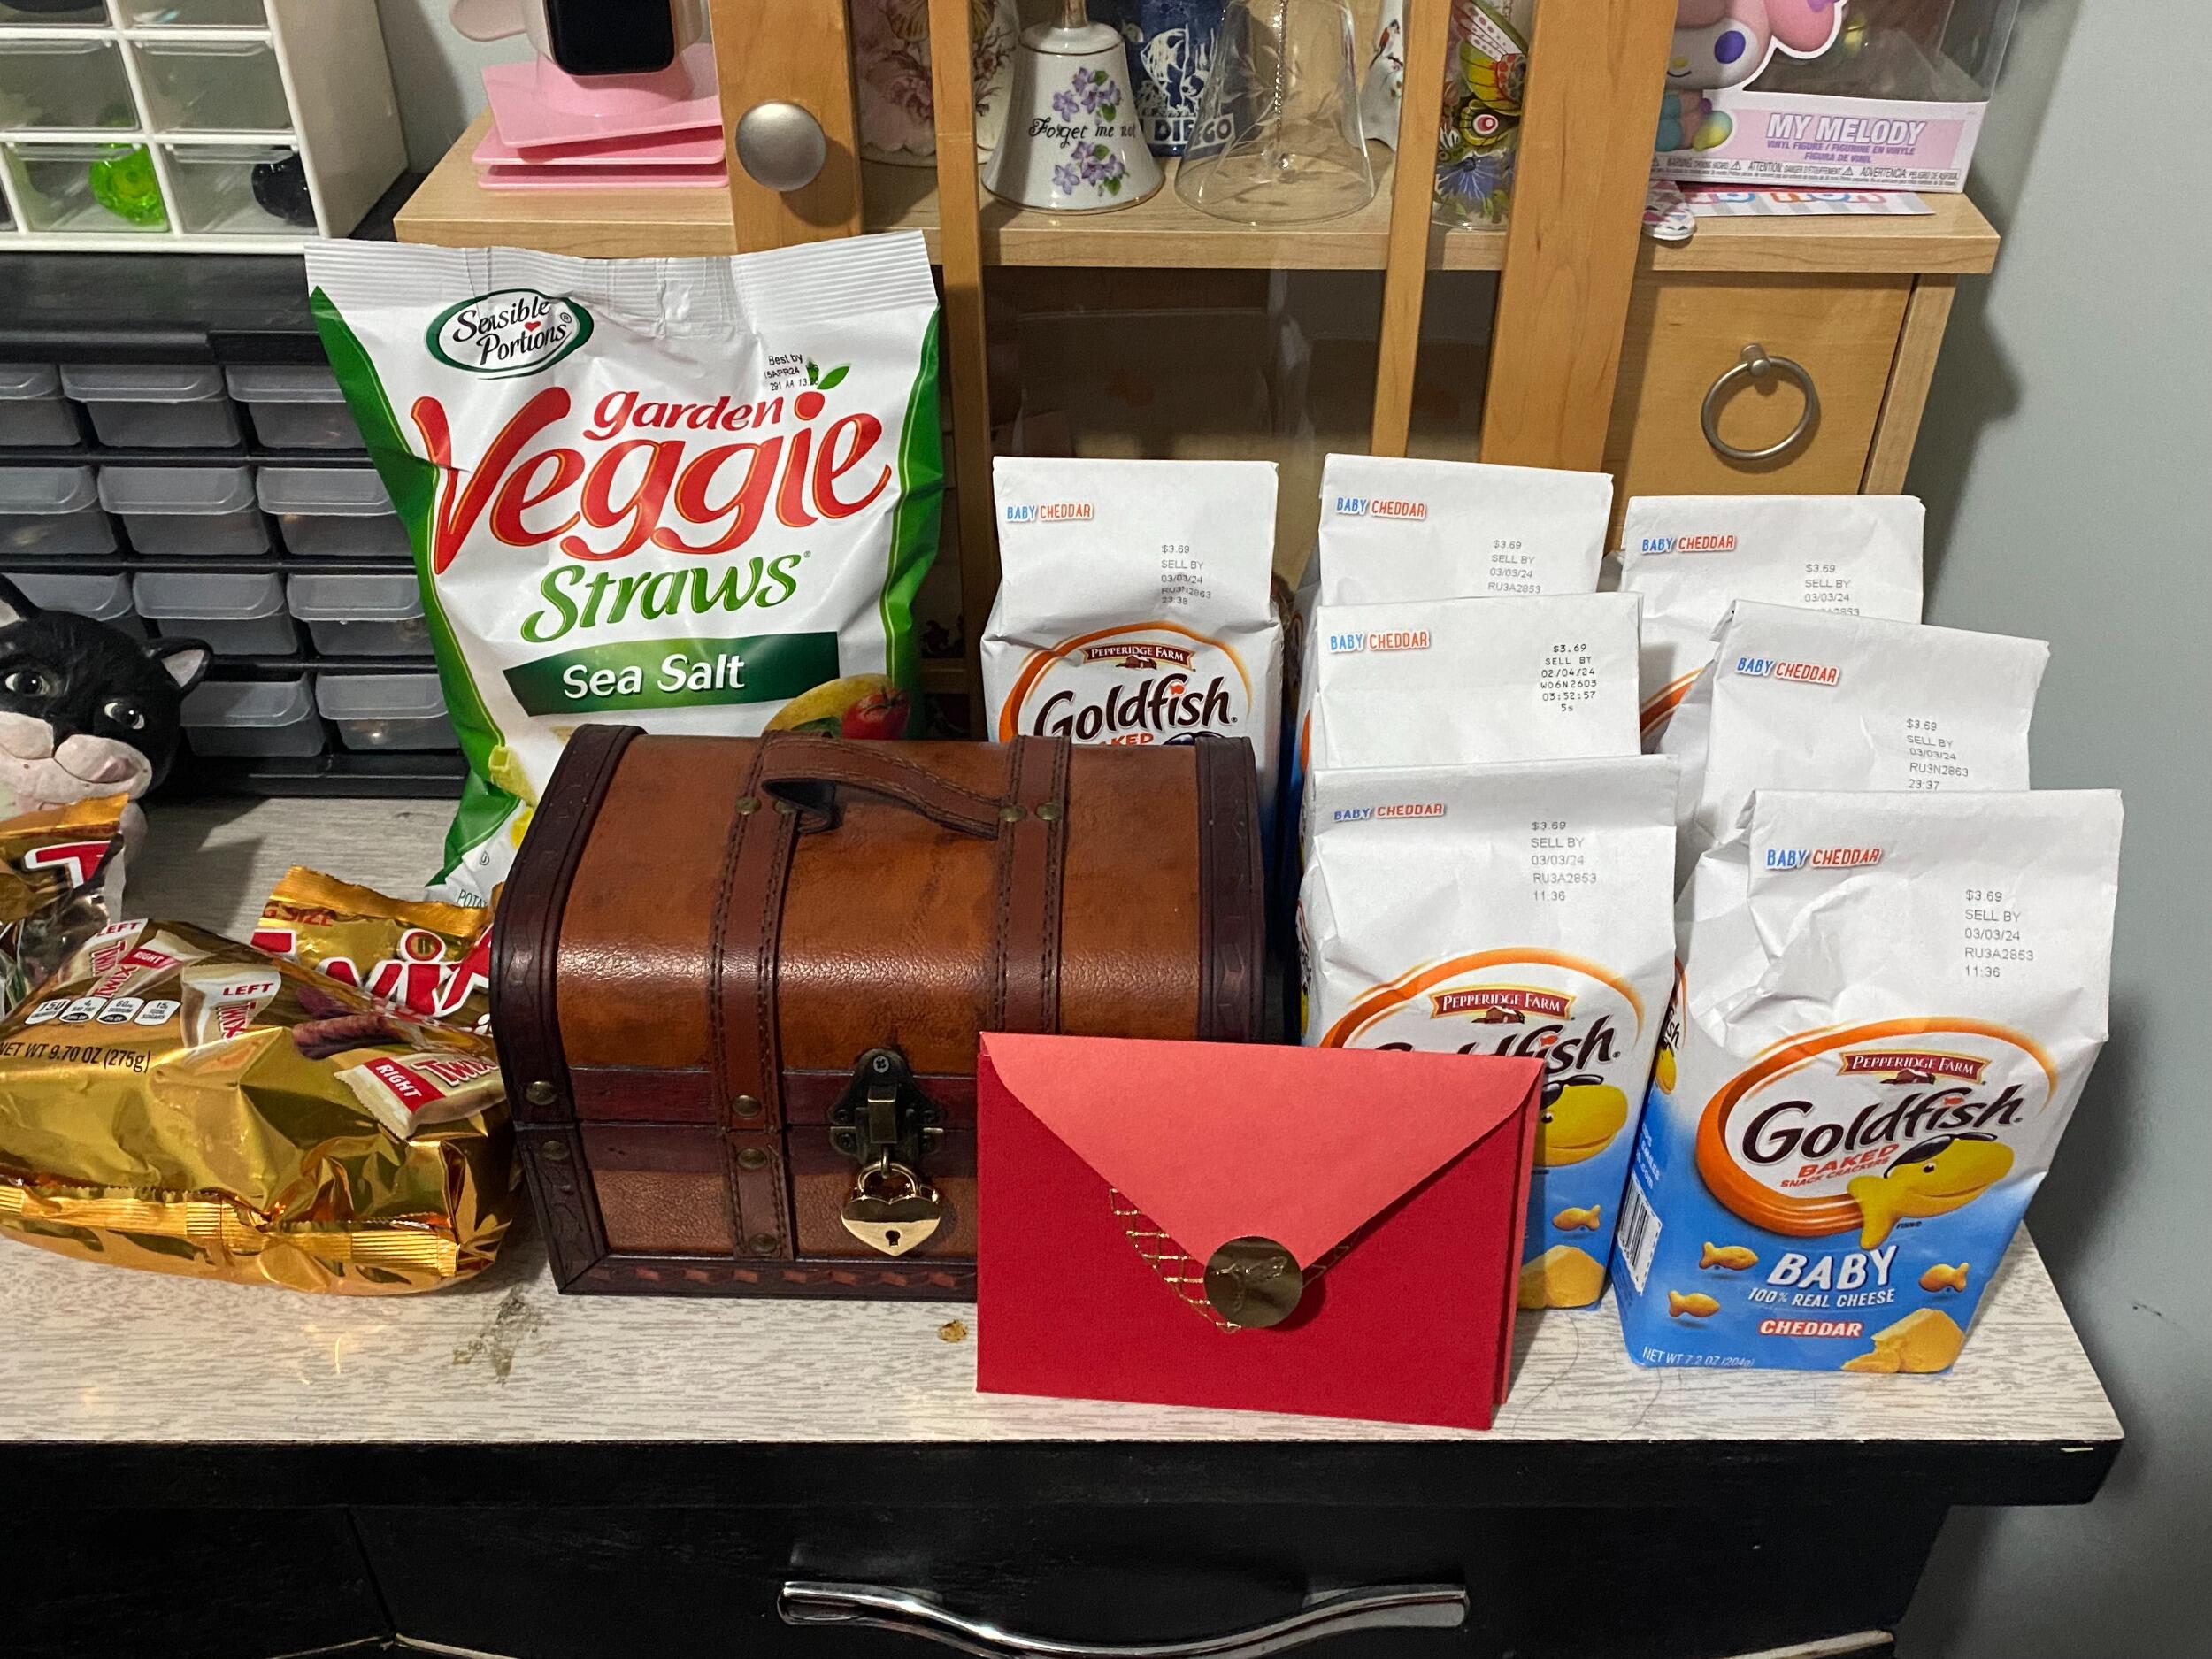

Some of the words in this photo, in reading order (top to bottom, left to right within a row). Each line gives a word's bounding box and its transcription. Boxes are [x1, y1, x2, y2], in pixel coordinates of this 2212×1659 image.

[1028, 117, 1088, 149] Forget
[1094, 124, 1114, 138] me
[1766, 112, 1813, 141] MY
[1815, 115, 1927, 146] MELODY
[1766, 141, 1790, 150] VINYL
[1793, 142, 1824, 150] FIGURE
[1831, 143, 1870, 153] FIGURINE
[1886, 146, 1916, 156] VINYLE
[1804, 152, 1835, 161] FIGURA
[1837, 153, 1848, 162] DE
[452, 296, 551, 342] Sensible
[476, 324, 567, 365] Portions
[768, 354, 790, 365] Best
[790, 354, 803, 364] by
[770, 381, 782, 391] 291
[582, 391, 784, 440] garden
[410, 386, 893, 576] Veggie
[1007, 506, 1035, 519] BABY
[1040, 503, 1090, 518] CHEDDAR
[1336, 497, 1367, 512] BABY
[1371, 500, 1425, 518] CHEDDAR
[1161, 544, 1190, 554] $3.69
[1494, 540, 1522, 550] $3.69
[1642, 538, 1675, 552] BABY
[1678, 535, 1734, 551] CHEDDAR
[1161, 559, 1187, 569] SELL
[1190, 560, 1204, 570] BY
[1491, 554, 1518, 565] SELL
[1521, 555, 1536, 565] BY
[1489, 568, 1532, 579] 03/03/24
[1805, 564, 1836, 574] $3.69
[1161, 573, 1202, 584] 03/03/24
[1805, 580, 1833, 588] SELL
[1836, 579, 1851, 588] BY
[520, 551, 803, 643] Straws
[1804, 593, 1849, 603] 03/03/24
[1330, 634, 1363, 651] BABY
[1369, 631, 1428, 649] CHEDDAR
[1553, 643, 1587, 654] $3.69
[1091, 646, 1153, 657] PEPPERIDGE
[1156, 649, 1184, 662] FARM
[1544, 657, 1571, 666] SELL
[1578, 656, 1592, 664] BY
[562, 664, 643, 701] Sea
[657, 652, 745, 691] Salt
[1540, 668, 1595, 679] 02/04/24
[1737, 657, 1774, 673] BABY
[1775, 663, 1838, 683] CHEDDAR
[1542, 691, 1596, 702] 03:52:57
[1033, 673, 1231, 740] Goldfish
[1907, 718, 1938, 732] $3.69
[1102, 733, 1153, 746] KED
[1907, 735, 1936, 747] SELL
[1939, 738, 1953, 748] BY
[1909, 748, 1956, 761] 03/03/24
[1333, 808, 1371, 821] BABY
[1376, 803, 1444, 817] CHEDDAR
[1531, 820, 1567, 831] $3.69
[1531, 837, 1564, 849] SELL
[1568, 836, 1585, 848] BY
[1531, 855, 1585, 866] 03/03/24
[1766, 849, 1808, 866] BABY
[1812, 848, 1881, 865] CHEDDAR
[1532, 872, 1597, 884] RU3A2853
[1533, 890, 1566, 902] 11:36
[1965, 889, 2002, 902] $3.69
[287, 905, 334, 927] SIZE
[1965, 909, 2000, 921] SELL
[2003, 910, 2022, 923] BY
[1964, 927, 2021, 941] 03/03/24
[134, 949, 165, 964] RIGHT
[1965, 947, 2034, 962] RU3A2853
[1965, 966, 2000, 978] 11:36
[223, 983, 273, 996] LEFT
[38, 1001, 65, 1011] 150
[1442, 992, 1518, 1010] PEPPERIDGE
[1525, 994, 1561, 1011] FARM
[220, 1002, 257, 1039] TWIX
[25, 1043, 50, 1058] WT
[50, 1044, 81, 1063] 9.70
[82, 1047, 102, 1064] OZ
[104, 1048, 151, 1074] (275g)
[1852, 1055, 1934, 1071] PEPPERIDGE
[1938, 1057, 1976, 1076] FARM
[411, 1059, 500, 1087] TWIX
[375, 1064, 423, 1099] RIGHT
[1742, 1084, 2024, 1164] Goldfish
[1798, 1143, 1900, 1179] BAKED
[1780, 1175, 1823, 1187] SNACK
[1826, 1157, 1890, 1179] CRACKERS
[1767, 1245, 1899, 1291] BABY
[1747, 1287, 1788, 1304] 100%
[1792, 1291, 1831, 1309] REAL
[1837, 1288, 1895, 1308] CHEESE
[1759, 1320, 1863, 1337] CHEDDAR
[1642, 1346, 1665, 1363] NET
[1666, 1353, 1684, 1363] WT
[1685, 1355, 1702, 1364] 7.2
[1704, 1356, 1721, 1365] OZ
